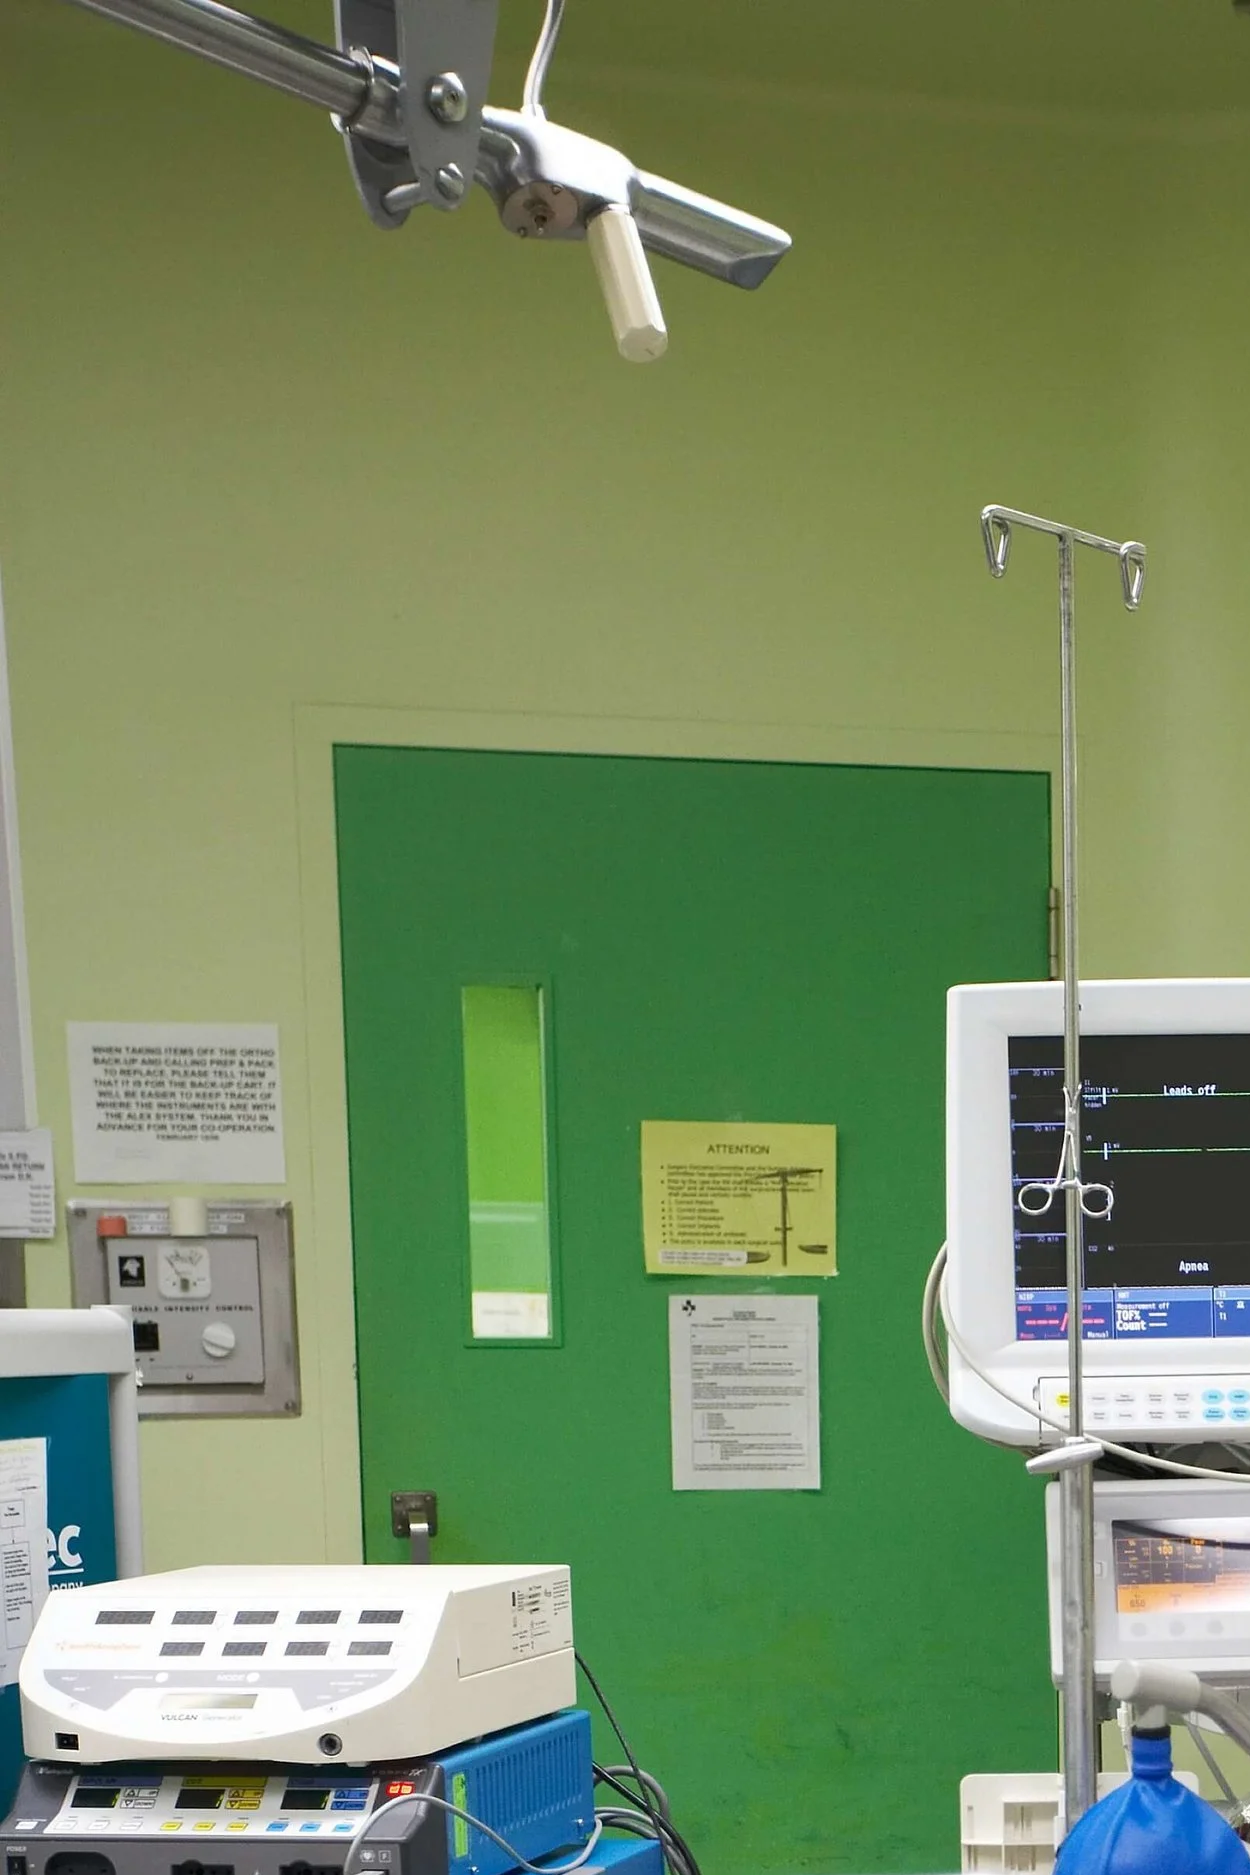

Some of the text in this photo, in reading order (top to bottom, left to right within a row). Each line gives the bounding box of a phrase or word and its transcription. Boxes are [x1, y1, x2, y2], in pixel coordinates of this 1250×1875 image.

[92, 1046, 122, 1055] WHEN
[142, 1058, 162, 1066] AND
[210, 1059, 236, 1067] PREP
[104, 1068, 116, 1077] TO
[170, 1069, 208, 1078] PLEASE
[214, 1070, 236, 1079] TELL
[240, 1070, 266, 1079] THEM
[94, 1079, 118, 1088] THAT
[122, 1079, 130, 1088] IT
[144, 1080, 164, 1089] FOR
[1163, 1084, 1216, 1096] Leads off
[124, 1091, 136, 1099] BE
[180, 1091, 194, 1100] TO
[96, 1102, 130, 1110] WHERE
[134, 1102, 152, 1111] THE
[156, 1102, 226, 1111] INSTRUMENTS
[228, 1103, 248, 1112] ARE
[106, 1112, 122, 1121] THE
[96, 1123, 142, 1132] ADVANCE
[146, 1123, 168, 1132] FOR
[170, 1124, 198, 1132] YOUR
[707, 1144, 769, 1155] ATTENTION
[1179, 1260, 1209, 1274] Apnea
[164, 1304, 254, 1312] INTENSITY CONTROL
[1116, 1321, 1147, 1332] Count
